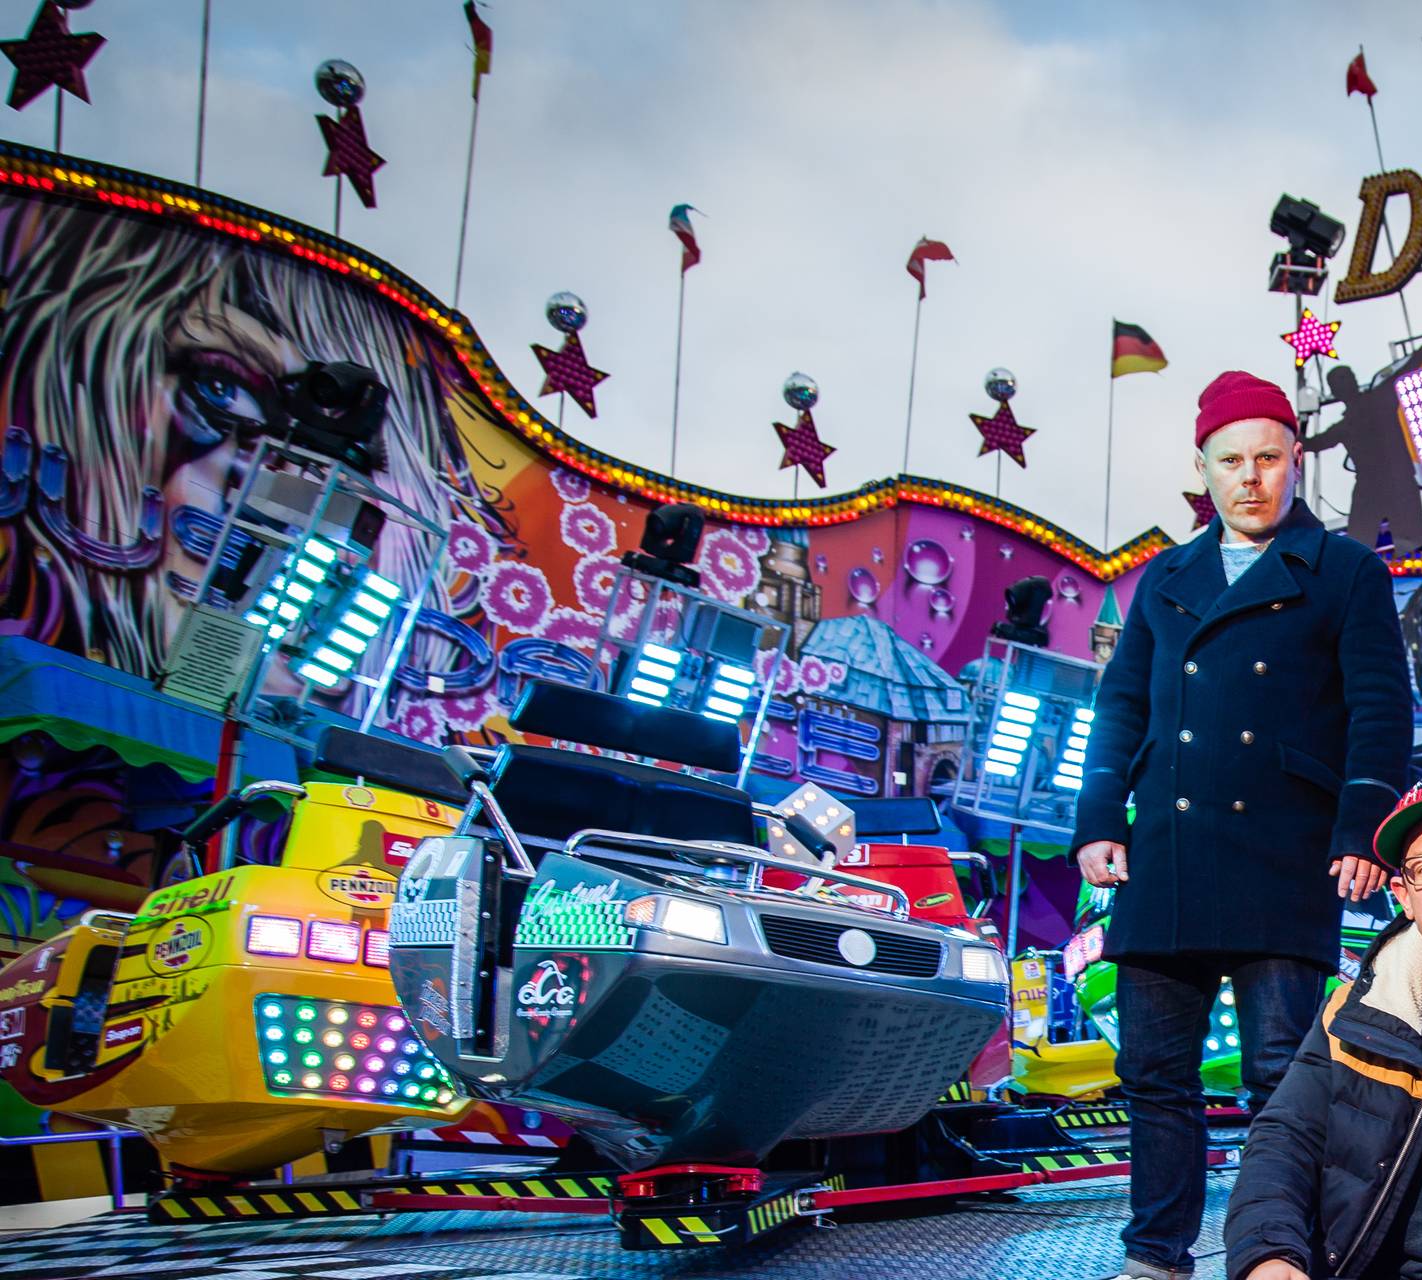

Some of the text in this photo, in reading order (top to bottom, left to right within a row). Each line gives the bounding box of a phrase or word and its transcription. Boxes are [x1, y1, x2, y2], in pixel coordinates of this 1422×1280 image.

[422, 800, 440, 818] 8
[330, 877, 398, 895] PENNZOIL
[149, 875, 235, 917] Shell
